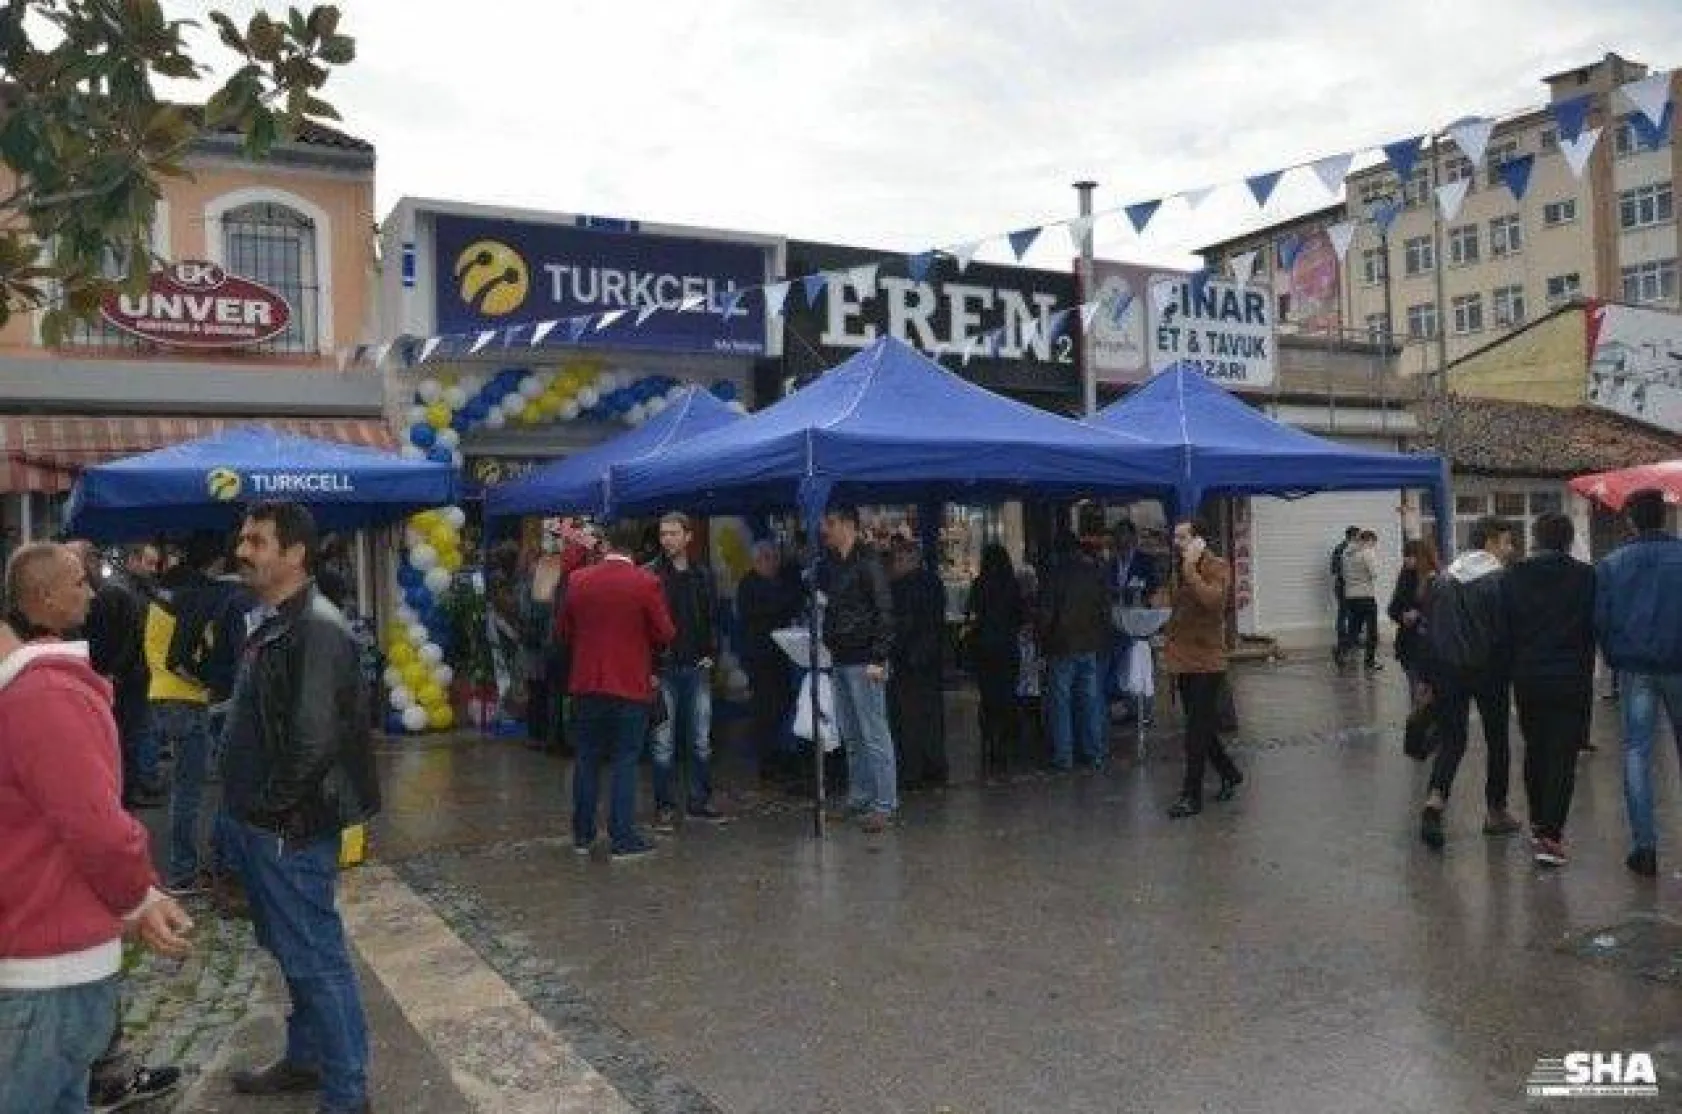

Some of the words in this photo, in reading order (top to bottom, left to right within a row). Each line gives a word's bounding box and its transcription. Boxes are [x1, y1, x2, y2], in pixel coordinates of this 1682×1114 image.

[543, 264, 748, 316] TURKCELL
[819, 267, 1058, 363] EREN
[1056, 336, 1074, 364] 2
[1157, 326, 1181, 353] ET
[1187, 330, 1201, 353] &
[1205, 330, 1266, 360] TAVUK
[1182, 358, 1248, 381] ZARI
[251, 473, 356, 493] TURKCELL
